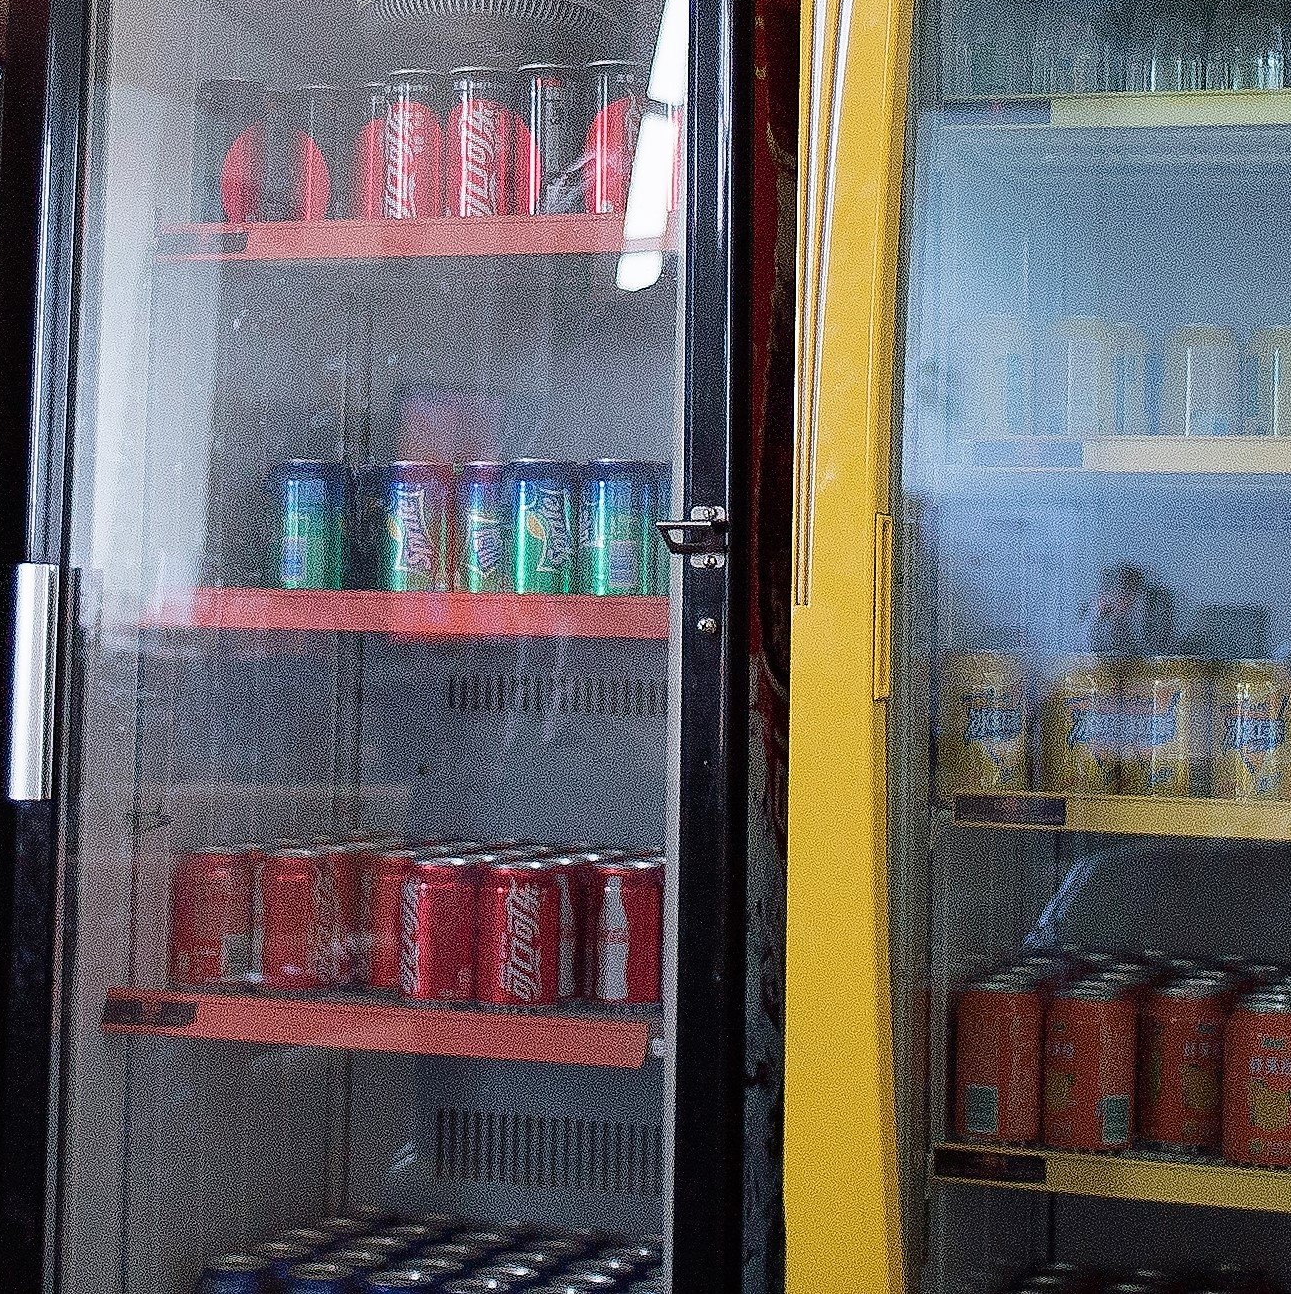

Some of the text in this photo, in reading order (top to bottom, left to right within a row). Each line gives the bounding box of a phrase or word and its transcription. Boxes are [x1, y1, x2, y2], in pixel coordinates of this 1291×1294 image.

[404, 494, 432, 571] Sprite
[546, 494, 573, 571] Sprite
[506, 876, 542, 1002] 可口可乐
